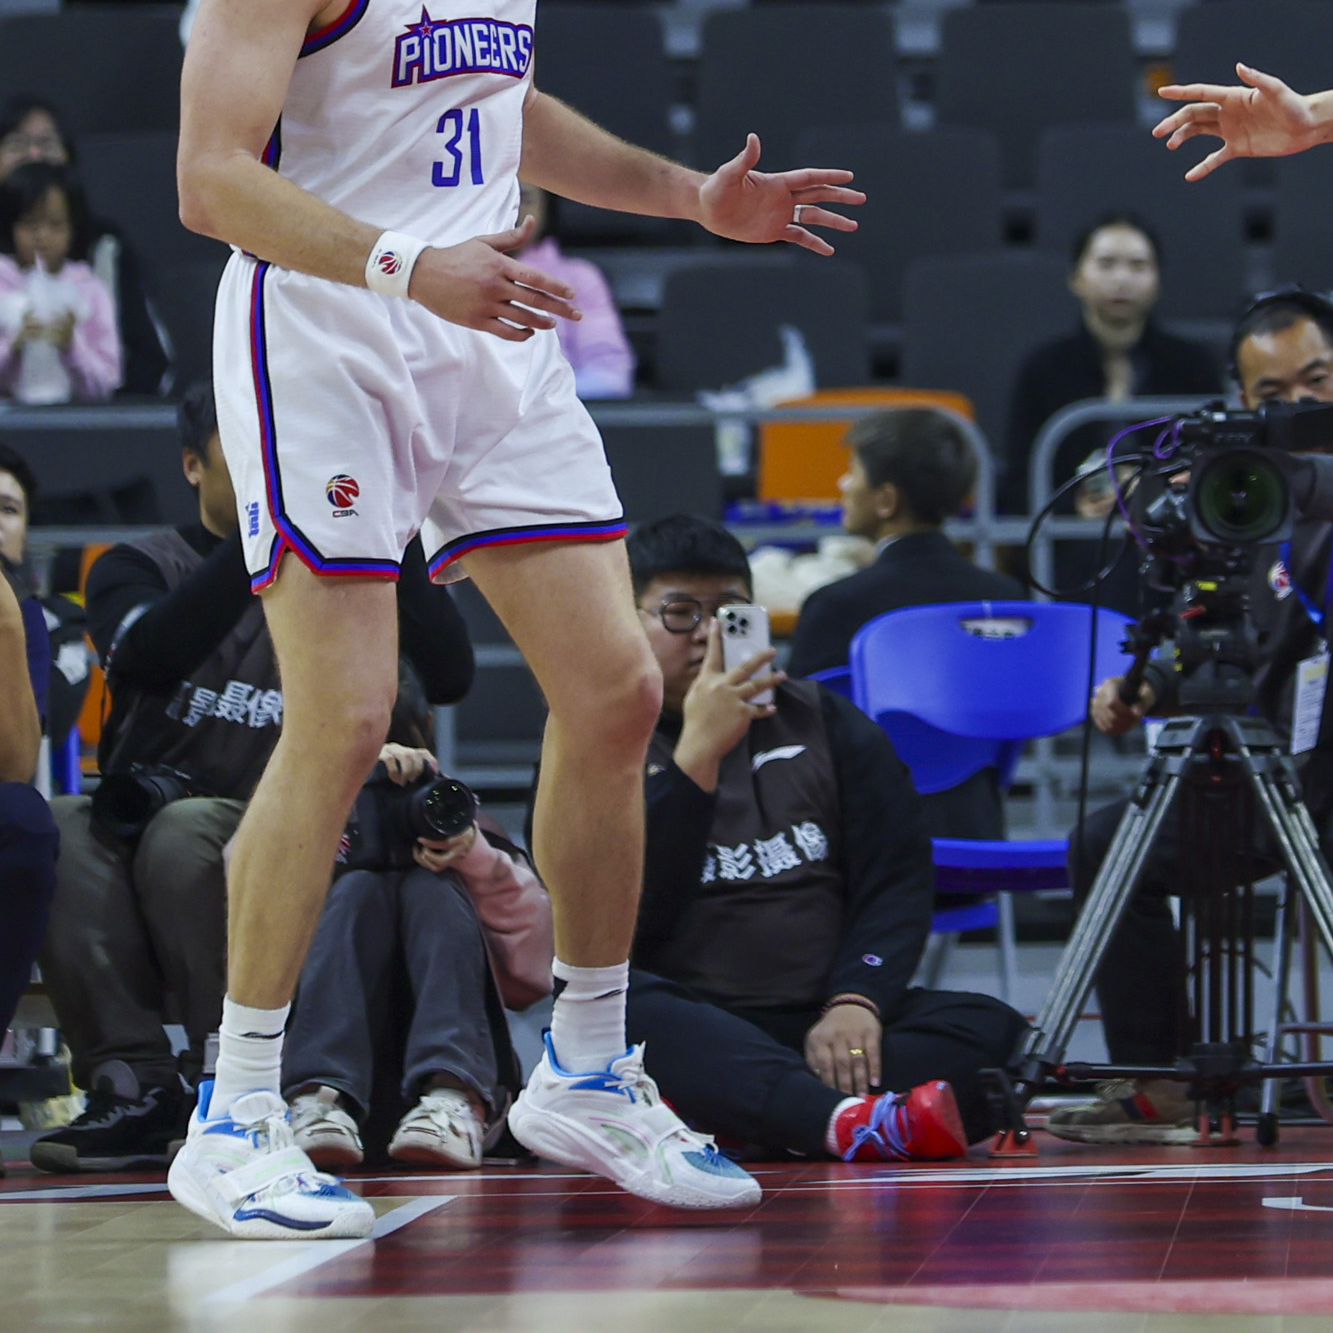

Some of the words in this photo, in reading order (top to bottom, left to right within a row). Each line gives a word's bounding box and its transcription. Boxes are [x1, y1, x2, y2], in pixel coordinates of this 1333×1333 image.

[393, 19, 535, 86] PIONEERS
[431, 108, 484, 187] 31
[332, 509, 359, 518] CBA
